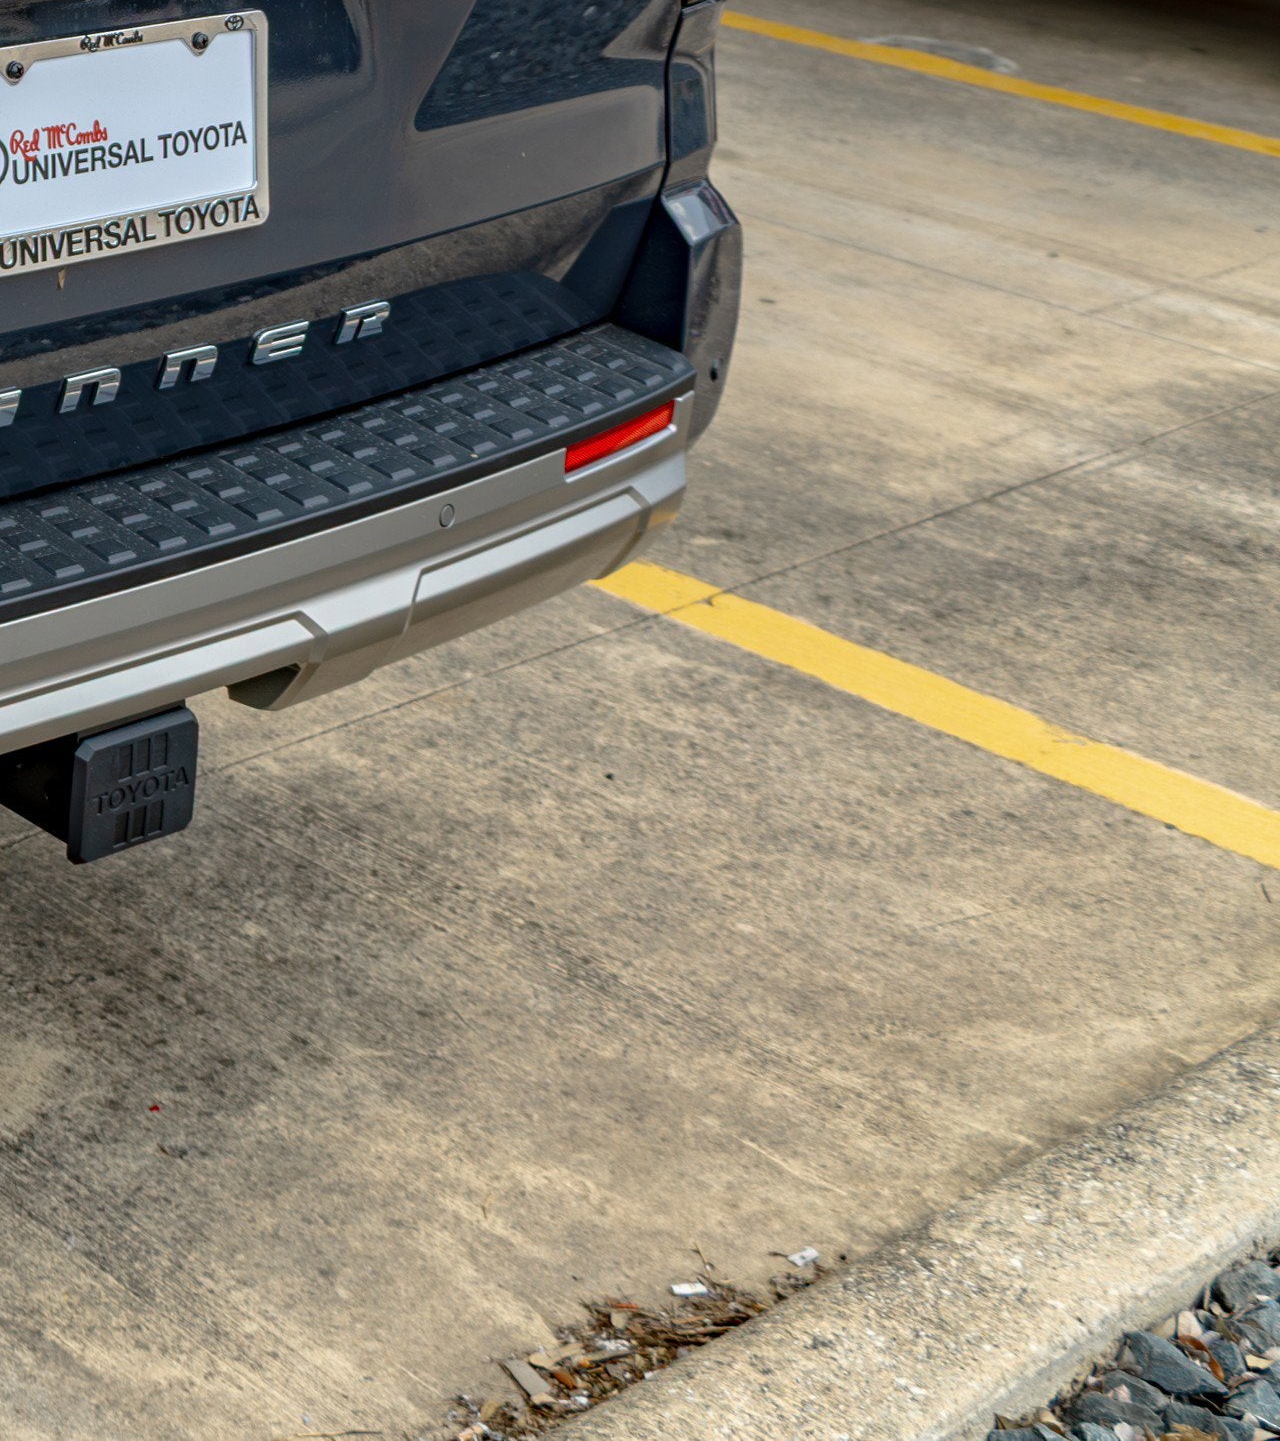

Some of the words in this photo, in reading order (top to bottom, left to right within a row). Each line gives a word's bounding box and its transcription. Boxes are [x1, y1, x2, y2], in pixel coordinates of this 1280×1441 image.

[10, 129, 40, 162] Red
[42, 120, 108, 149] McCombs
[11, 138, 154, 185] UNIVERSAL
[157, 120, 248, 159] TOYOTA
[158, 194, 260, 237] TOYOTA
[92, 765, 189, 816] TOYOTA
